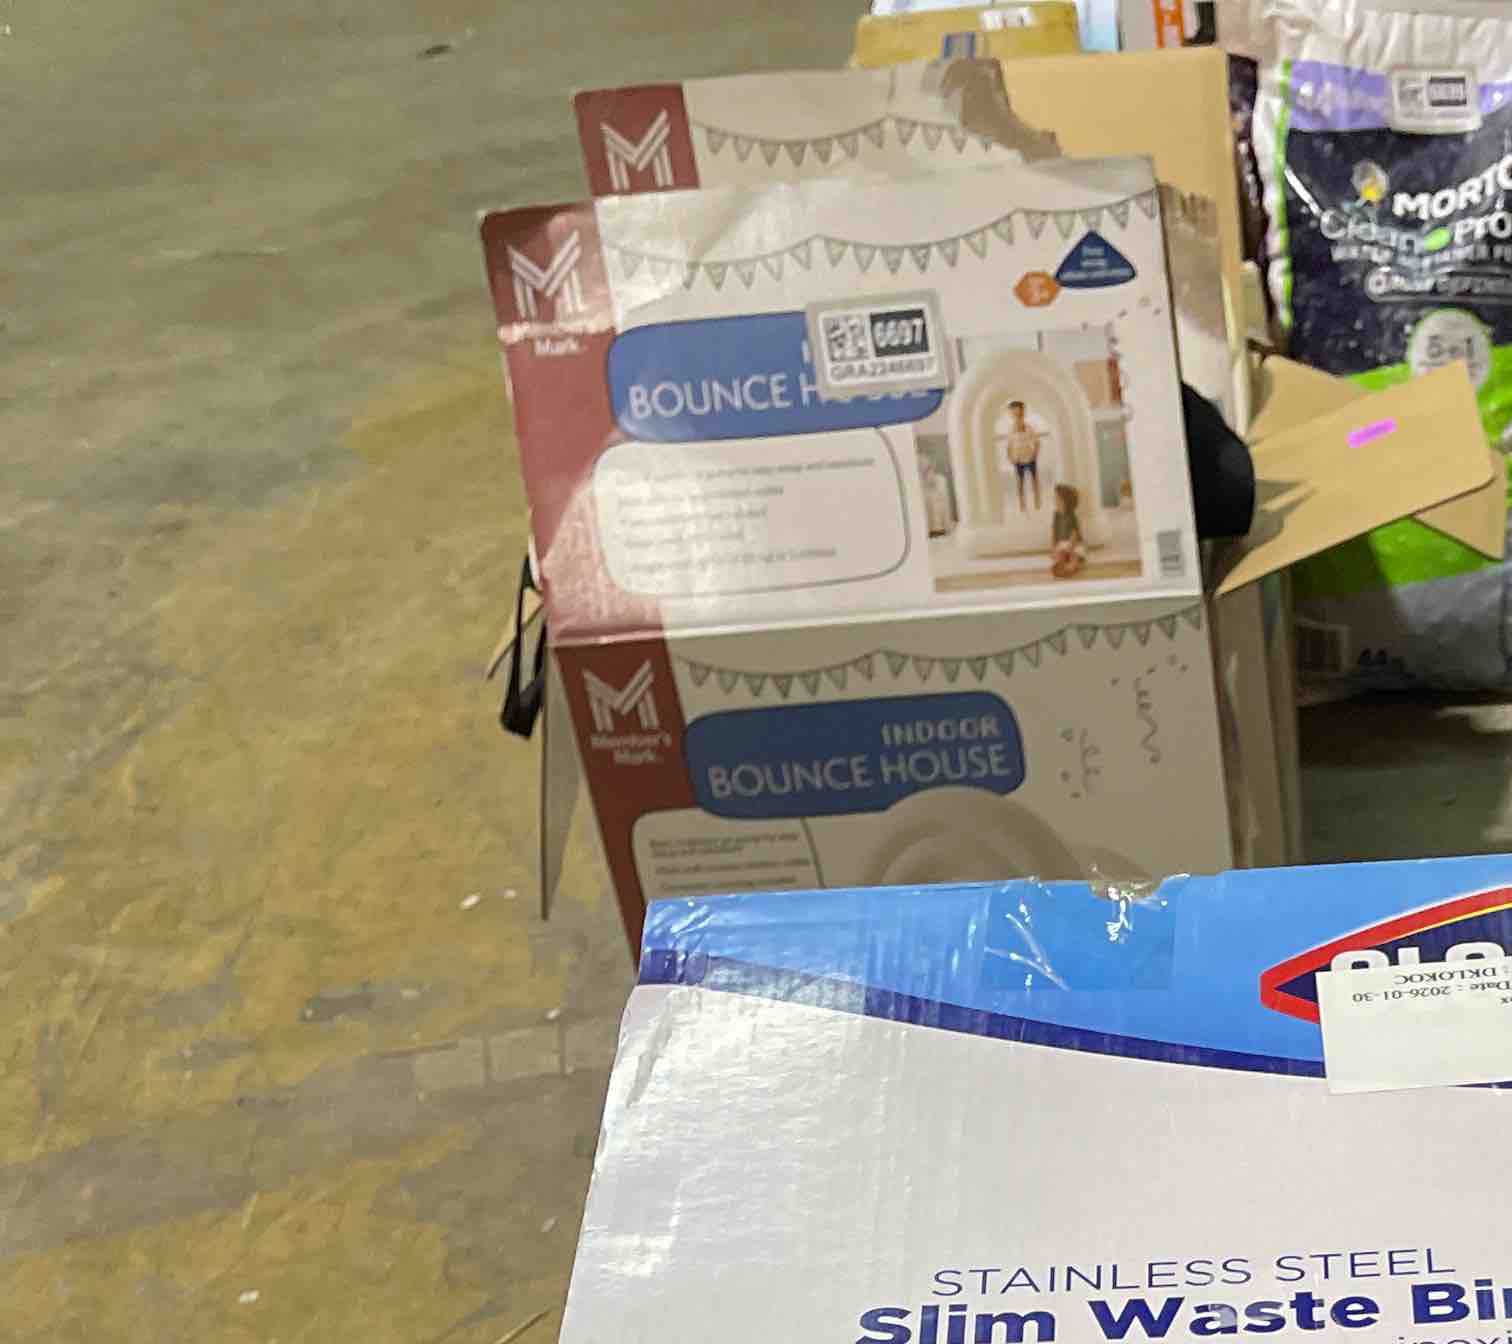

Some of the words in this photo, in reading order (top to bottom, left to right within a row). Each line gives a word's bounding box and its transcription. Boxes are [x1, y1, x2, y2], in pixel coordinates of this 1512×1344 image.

[629, 373, 790, 420] BOUNCE
[882, 715, 1000, 746] INDOOR
[707, 755, 873, 798] BOUNCE
[880, 743, 1010, 784] HOUSE
[1353, 985, 1452, 1002] 2026-01-30
[1394, 966, 1497, 984] DKLOKOC
[1469, 980, 1511, 991] Date
[932, 1256, 1252, 1297] STAINLESS
[1274, 1247, 1456, 1281] STEEL
[1088, 1291, 1380, 1342] Waste
